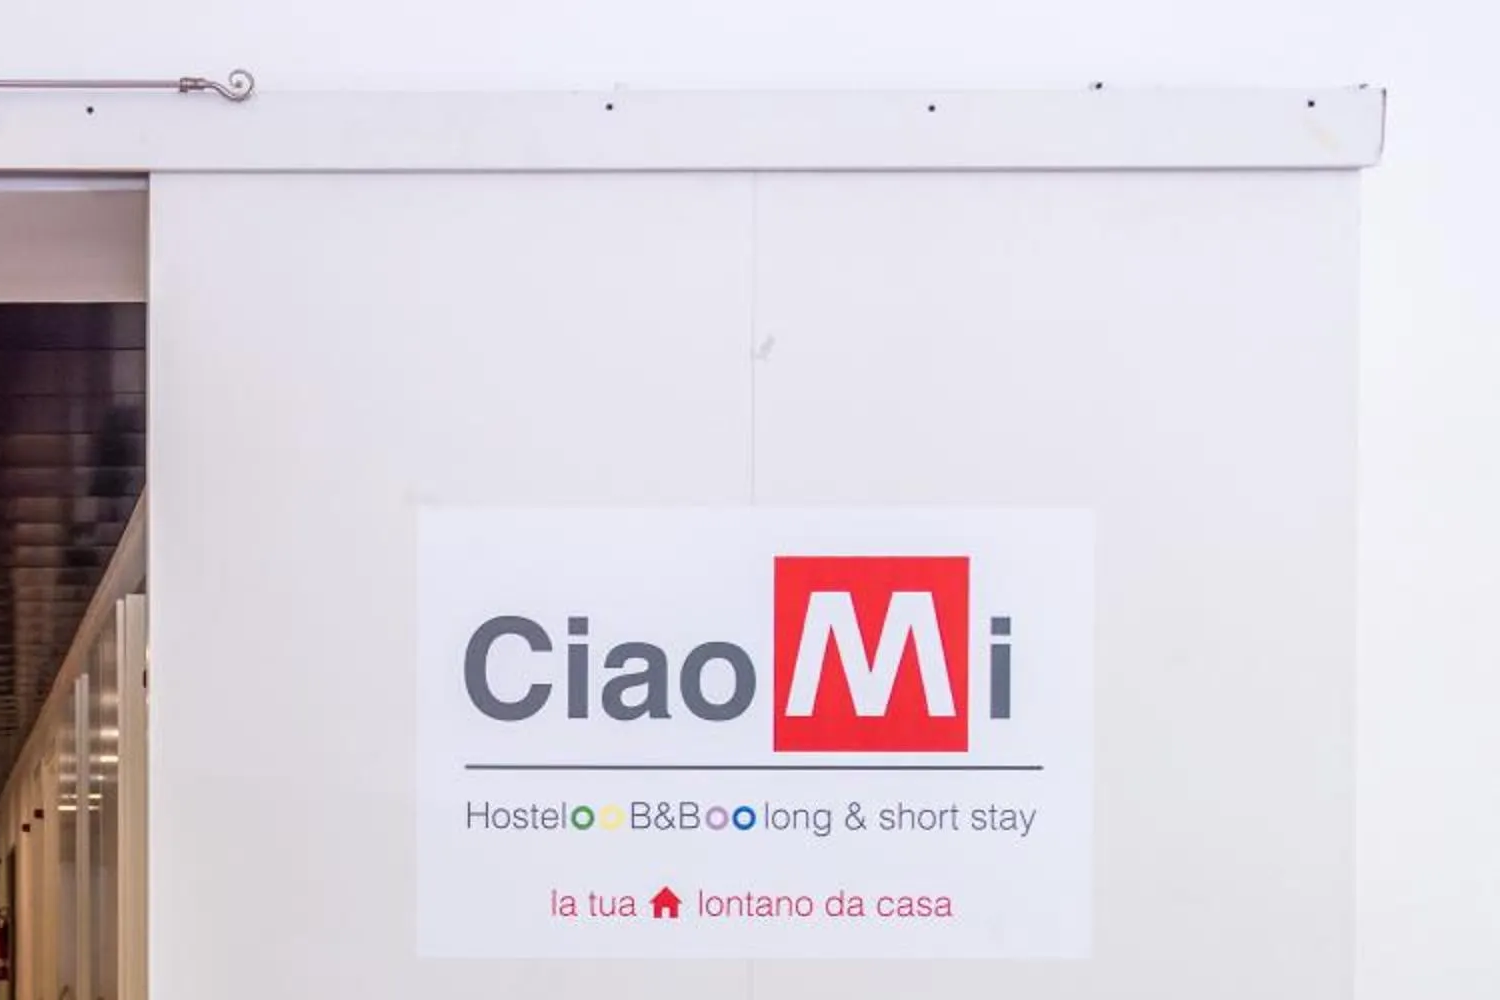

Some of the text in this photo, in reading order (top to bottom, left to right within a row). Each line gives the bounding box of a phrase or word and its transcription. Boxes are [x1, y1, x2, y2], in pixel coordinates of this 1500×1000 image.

[466, 801, 1036, 837] Hostel B&B long & short stay
[551, 889, 953, 919] la tua lontano da casa
